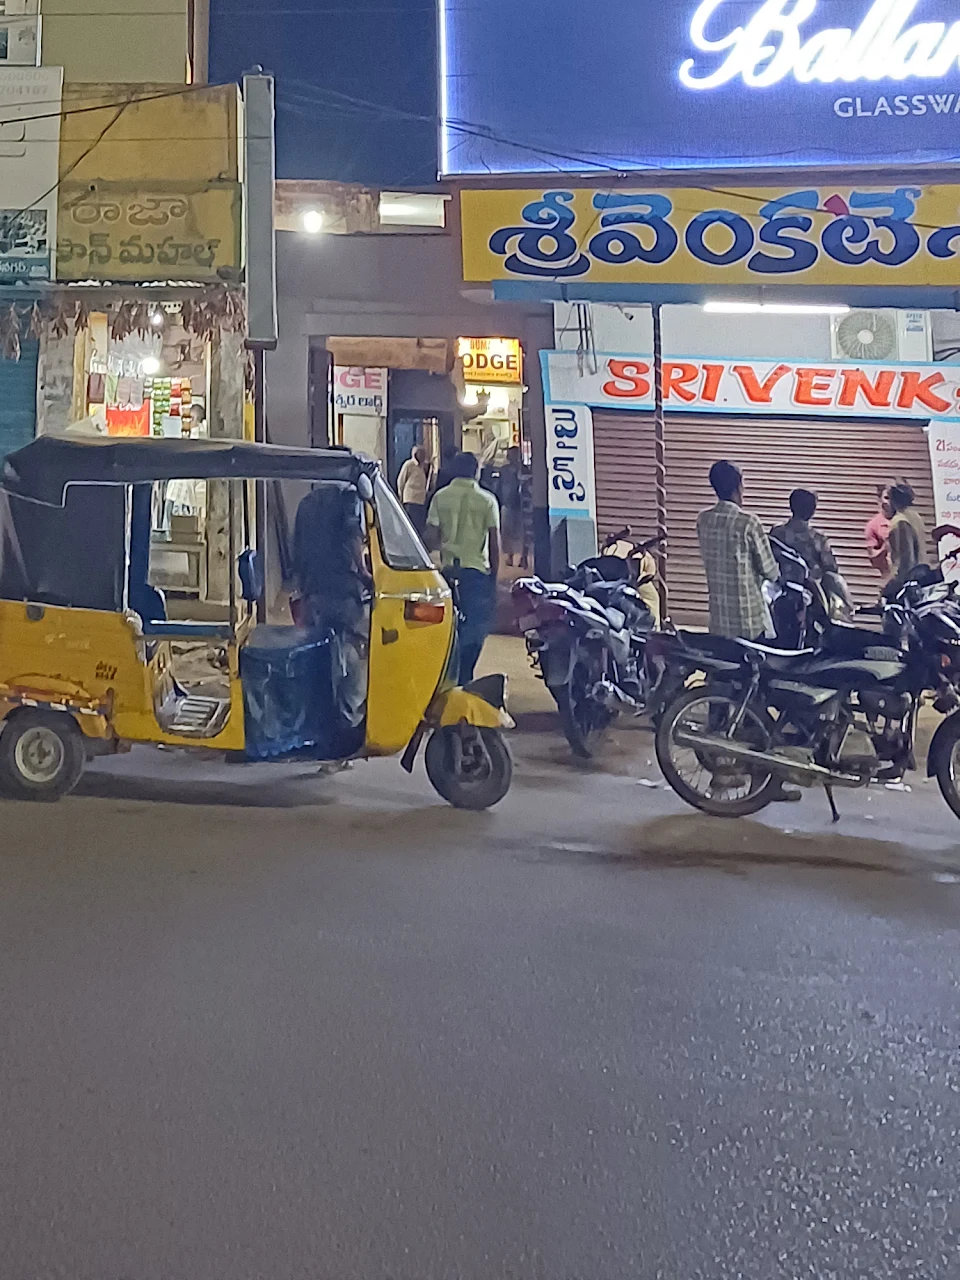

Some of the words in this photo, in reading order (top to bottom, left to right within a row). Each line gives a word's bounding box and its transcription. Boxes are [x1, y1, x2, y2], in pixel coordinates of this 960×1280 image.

[833, 94, 960, 117] GLASSW
[462, 352, 518, 371] ODGE
[602, 359, 960, 413] SRIVENK
